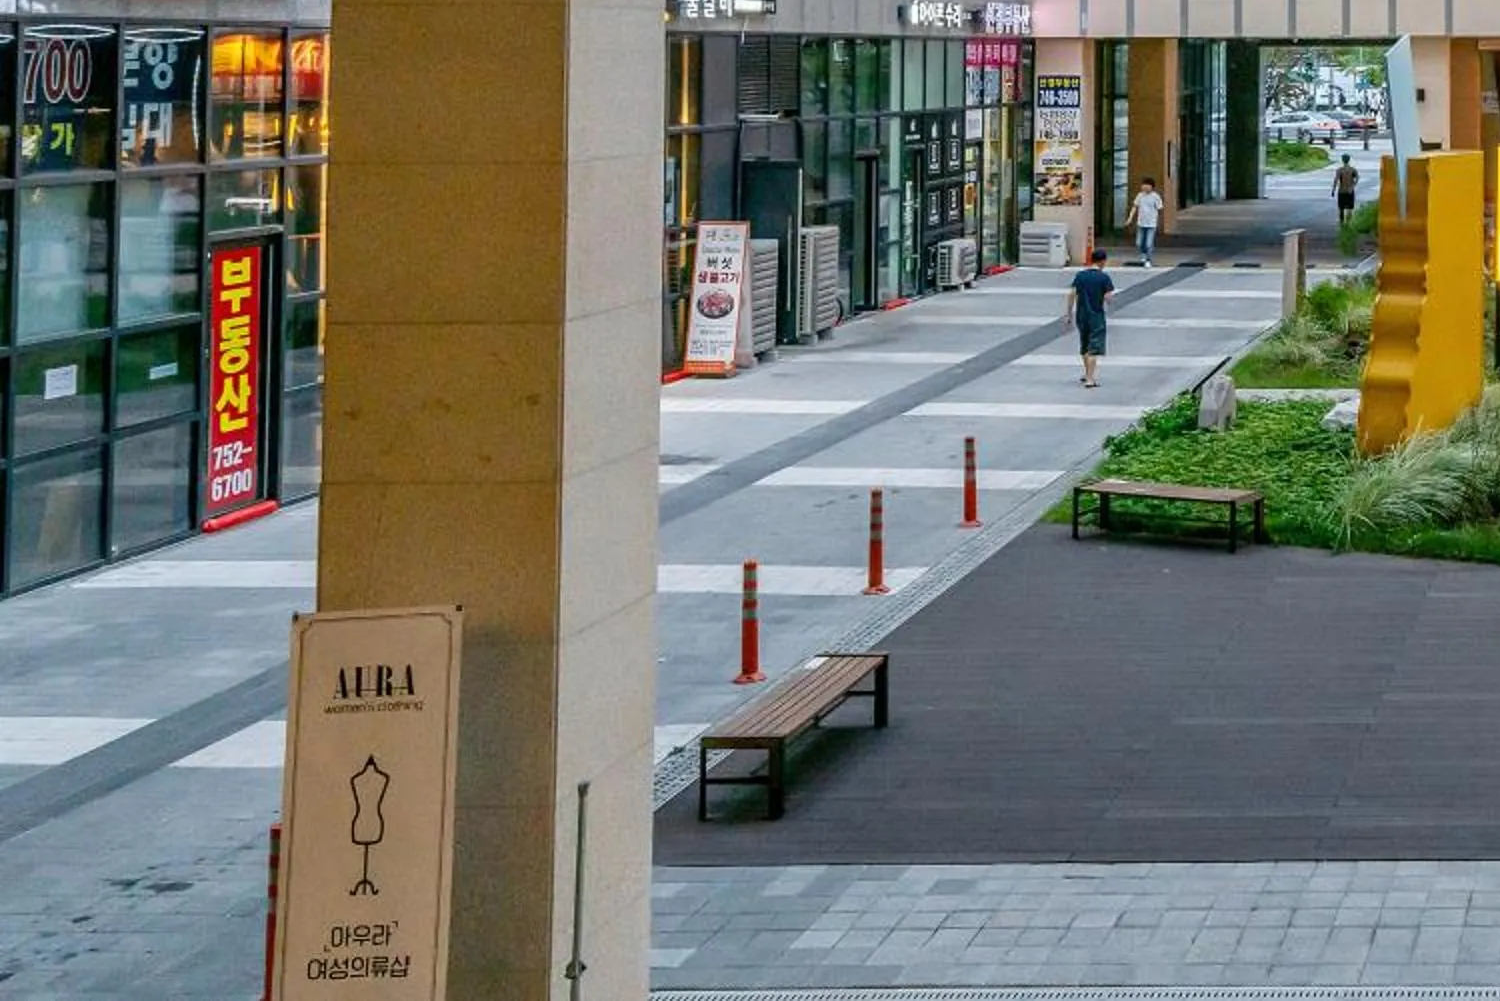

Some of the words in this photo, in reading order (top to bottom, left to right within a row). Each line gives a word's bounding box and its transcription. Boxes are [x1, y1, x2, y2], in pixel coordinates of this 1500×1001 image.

[215, 256, 252, 434] 부동산
[212, 442, 252, 471] 752-
[211, 468, 252, 502] 6700
[333, 664, 416, 700] AURA
[306, 955, 412, 981] 여성의류샵
